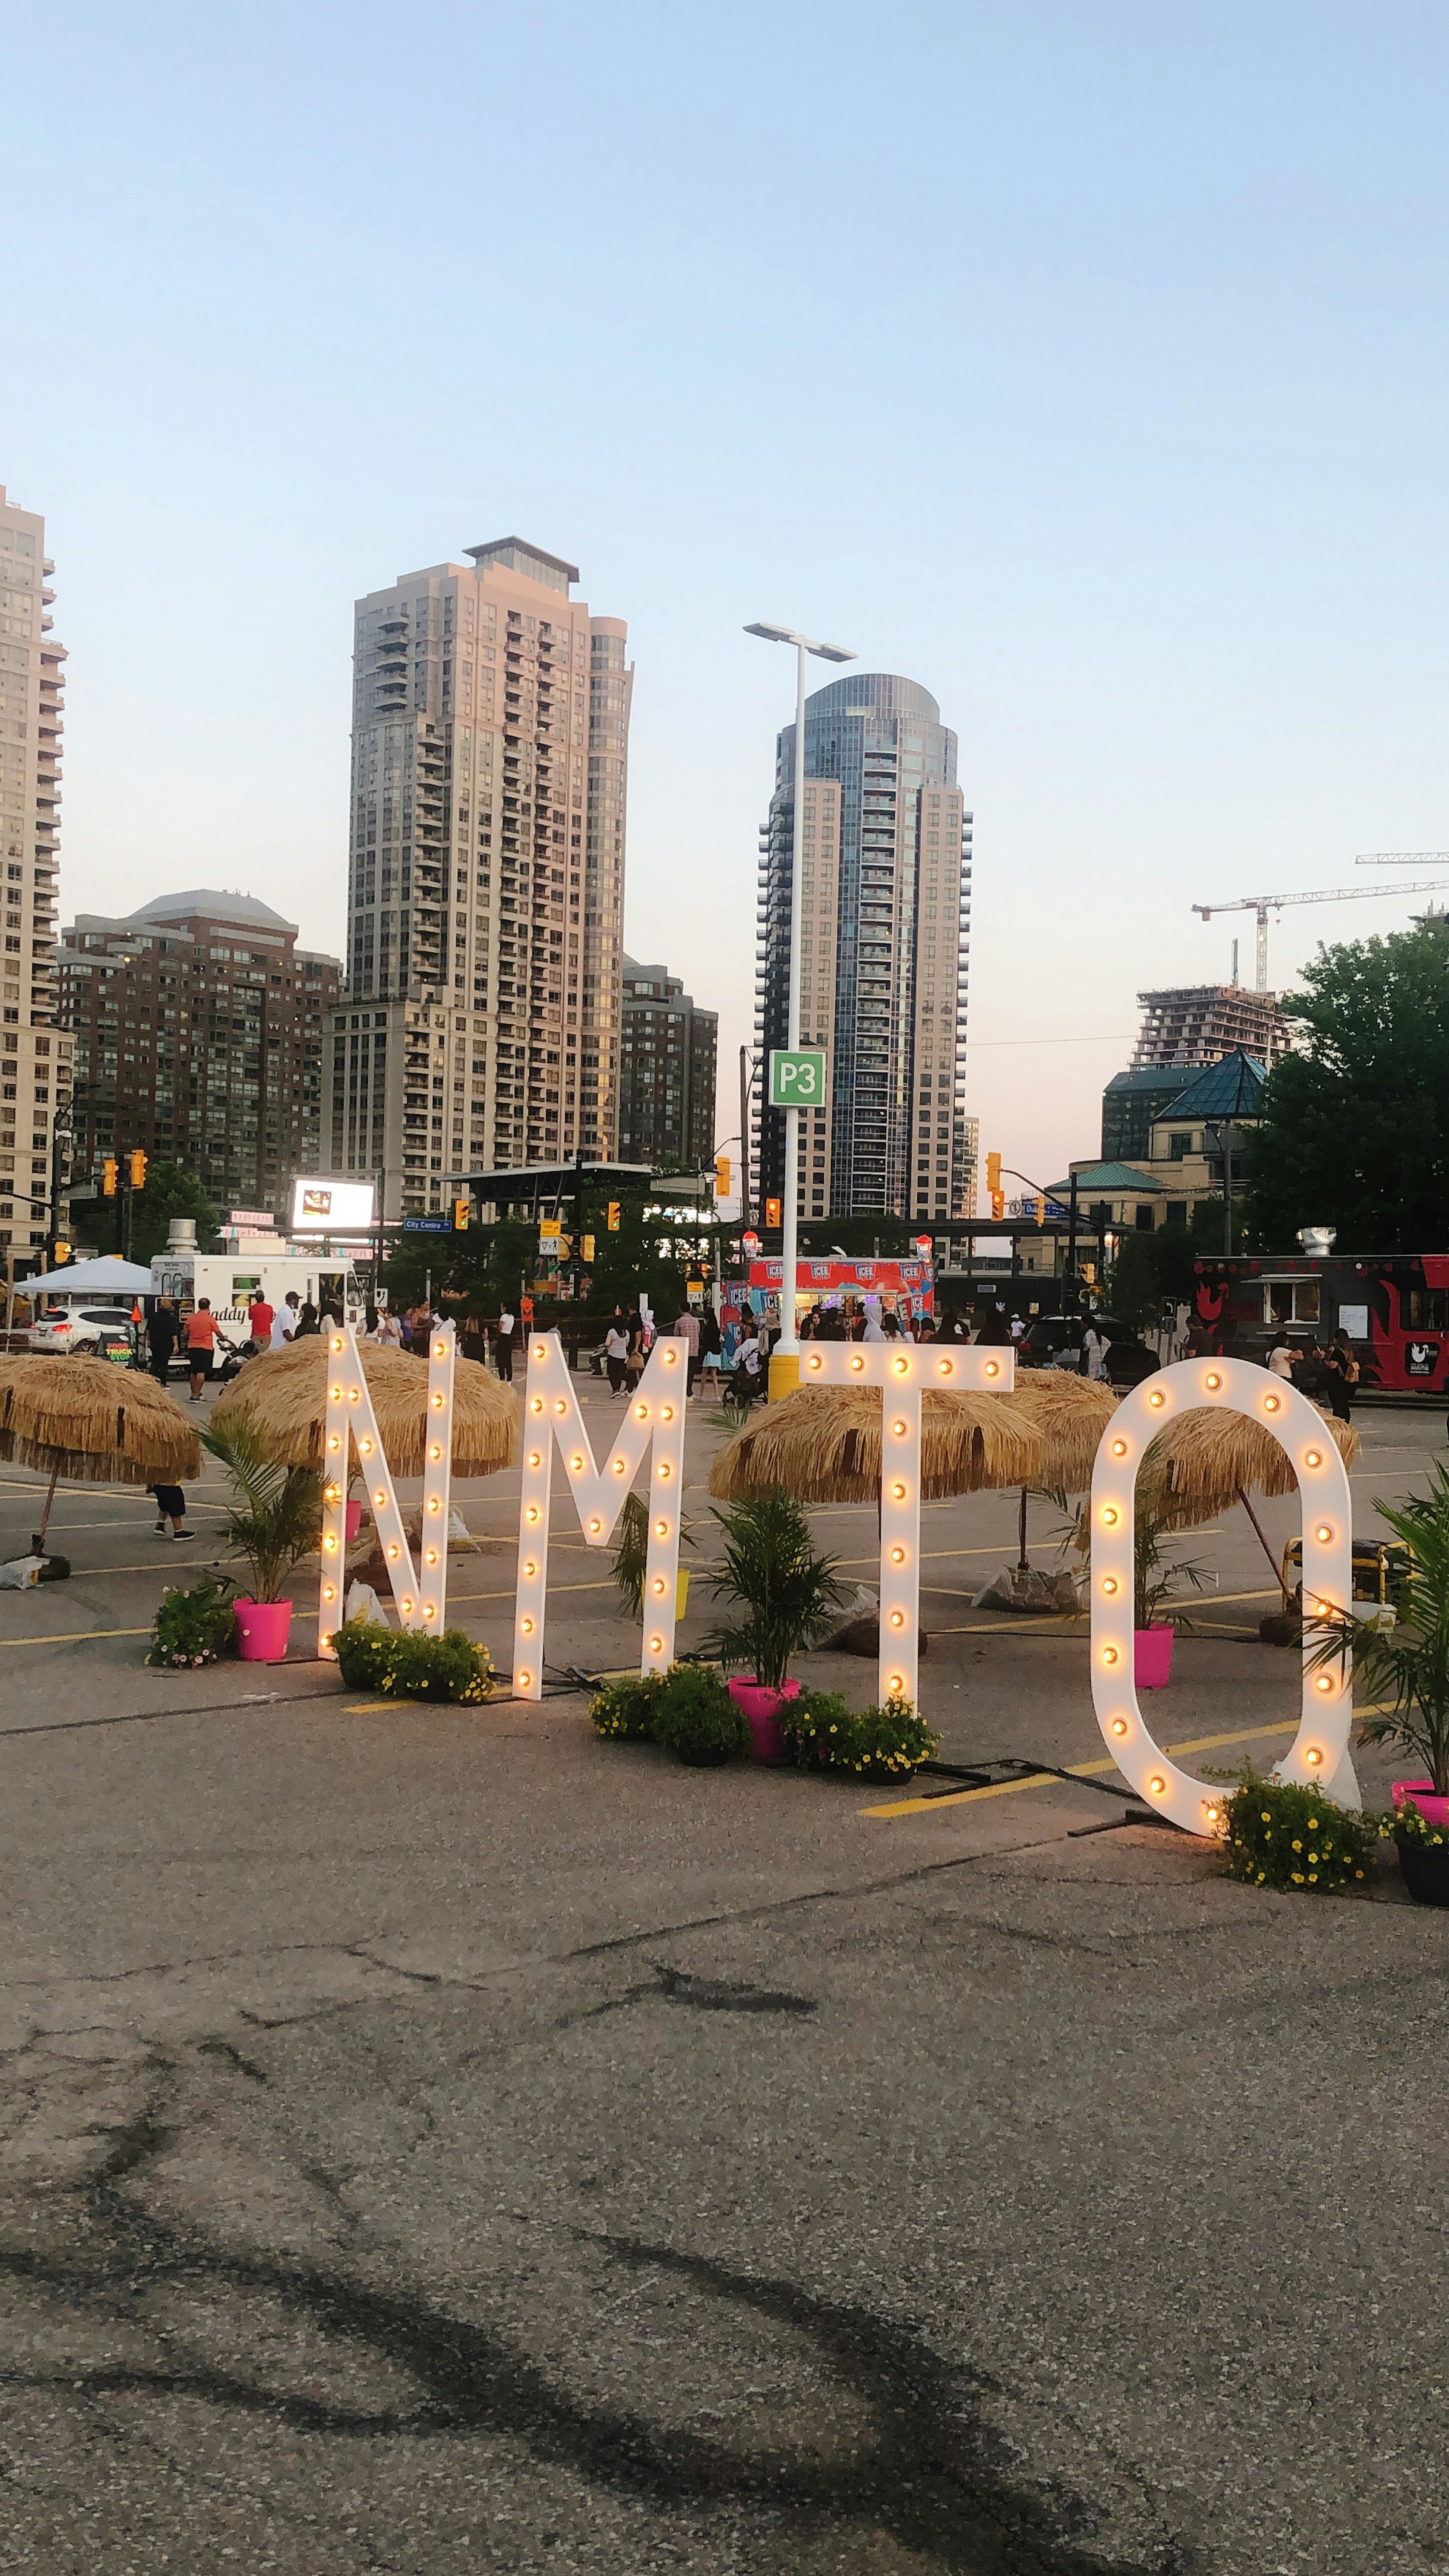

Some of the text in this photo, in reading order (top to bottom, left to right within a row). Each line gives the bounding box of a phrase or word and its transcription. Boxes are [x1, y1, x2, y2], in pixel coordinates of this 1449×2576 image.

[780, 1062, 815, 1094] P3
[407, 1221, 419, 1229] City
[814, 1266, 828, 1275] ICEE
[858, 1267, 873, 1276] ICEE
[903, 1267, 918, 1276] ICEE
[730, 1288, 747, 1305] ICEE
[211, 1307, 245, 1324] addy
